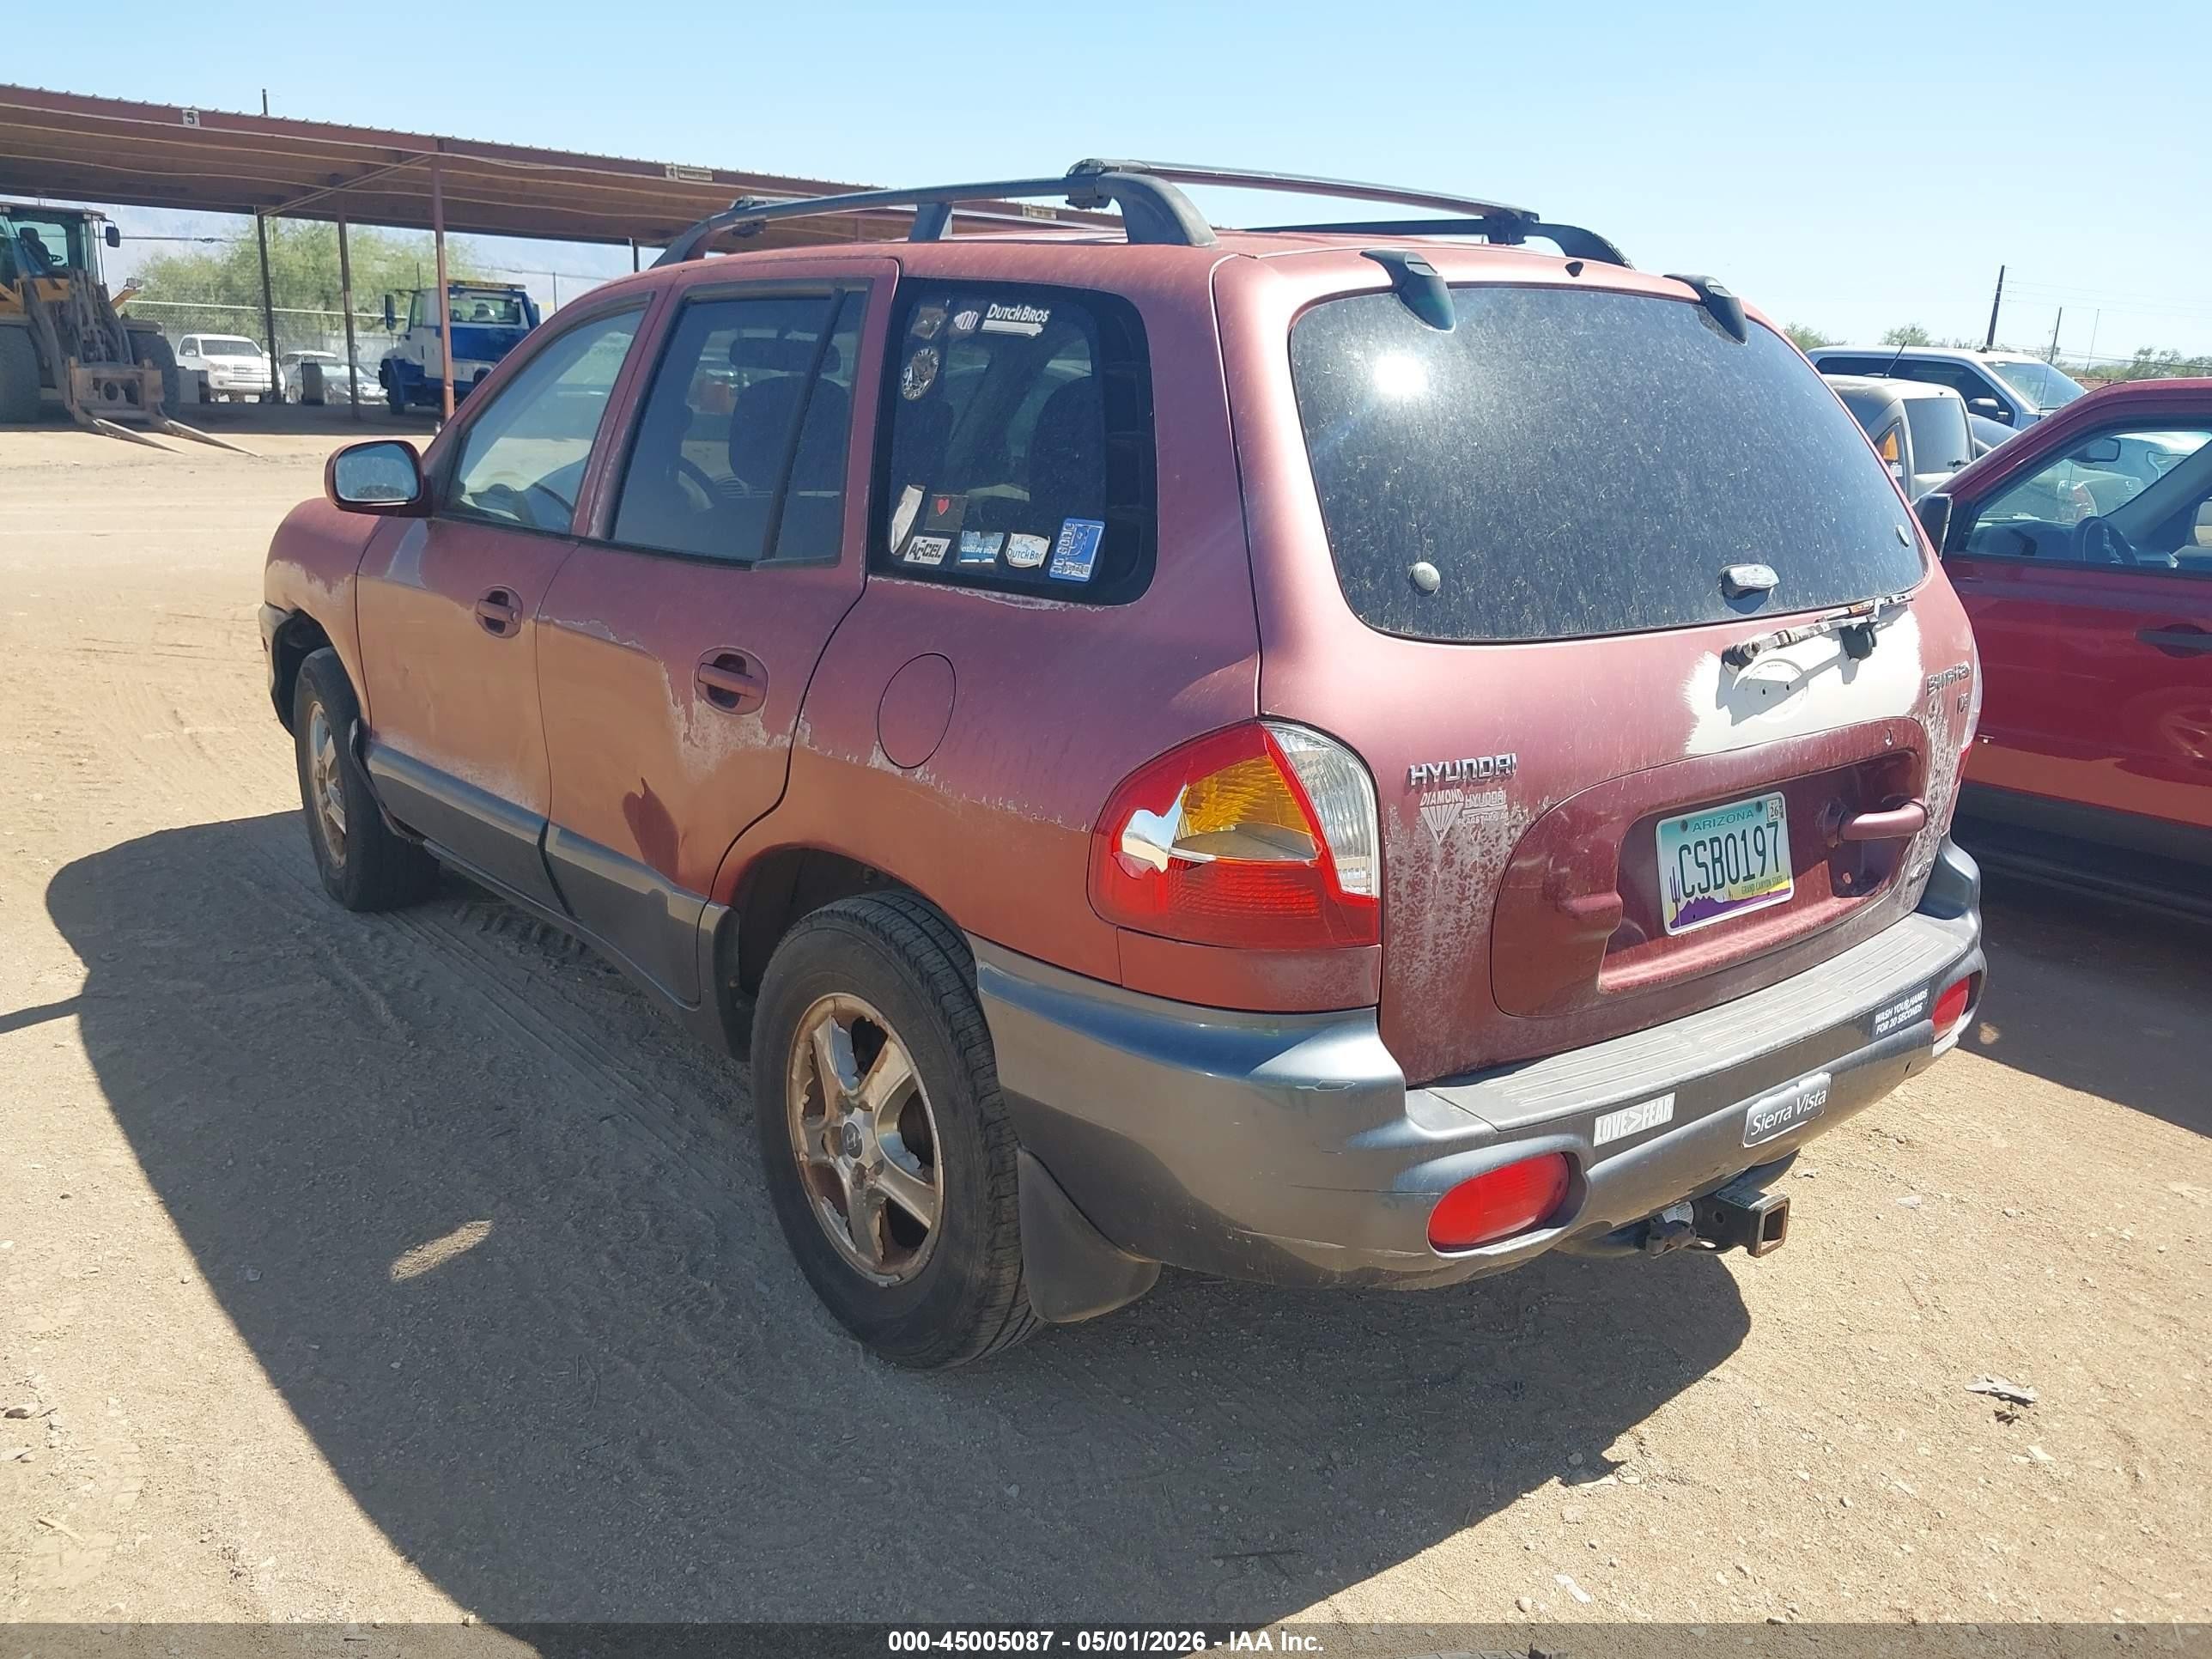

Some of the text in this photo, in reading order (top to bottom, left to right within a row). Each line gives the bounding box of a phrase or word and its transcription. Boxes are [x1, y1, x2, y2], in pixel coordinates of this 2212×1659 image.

[187, 112, 195, 124] 5
[1019, 305, 1050, 323] BROS
[1007, 548, 1030, 560] DUTCH
[1410, 752, 1517, 786] HYUNDAI
[1419, 788, 1465, 806] DIAMOND
[1465, 789, 1506, 808] HYUNDAI
[1692, 810, 1754, 832] ARIZONA
[1770, 805, 1779, 817] 26
[1679, 821, 1779, 898] CSB0197
[1875, 988, 1928, 1024] WASH YOUR HANDS
[1876, 1002, 1923, 1036] FOR 20 SECONDS
[1751, 1089, 1827, 1136] Sierra Vista
